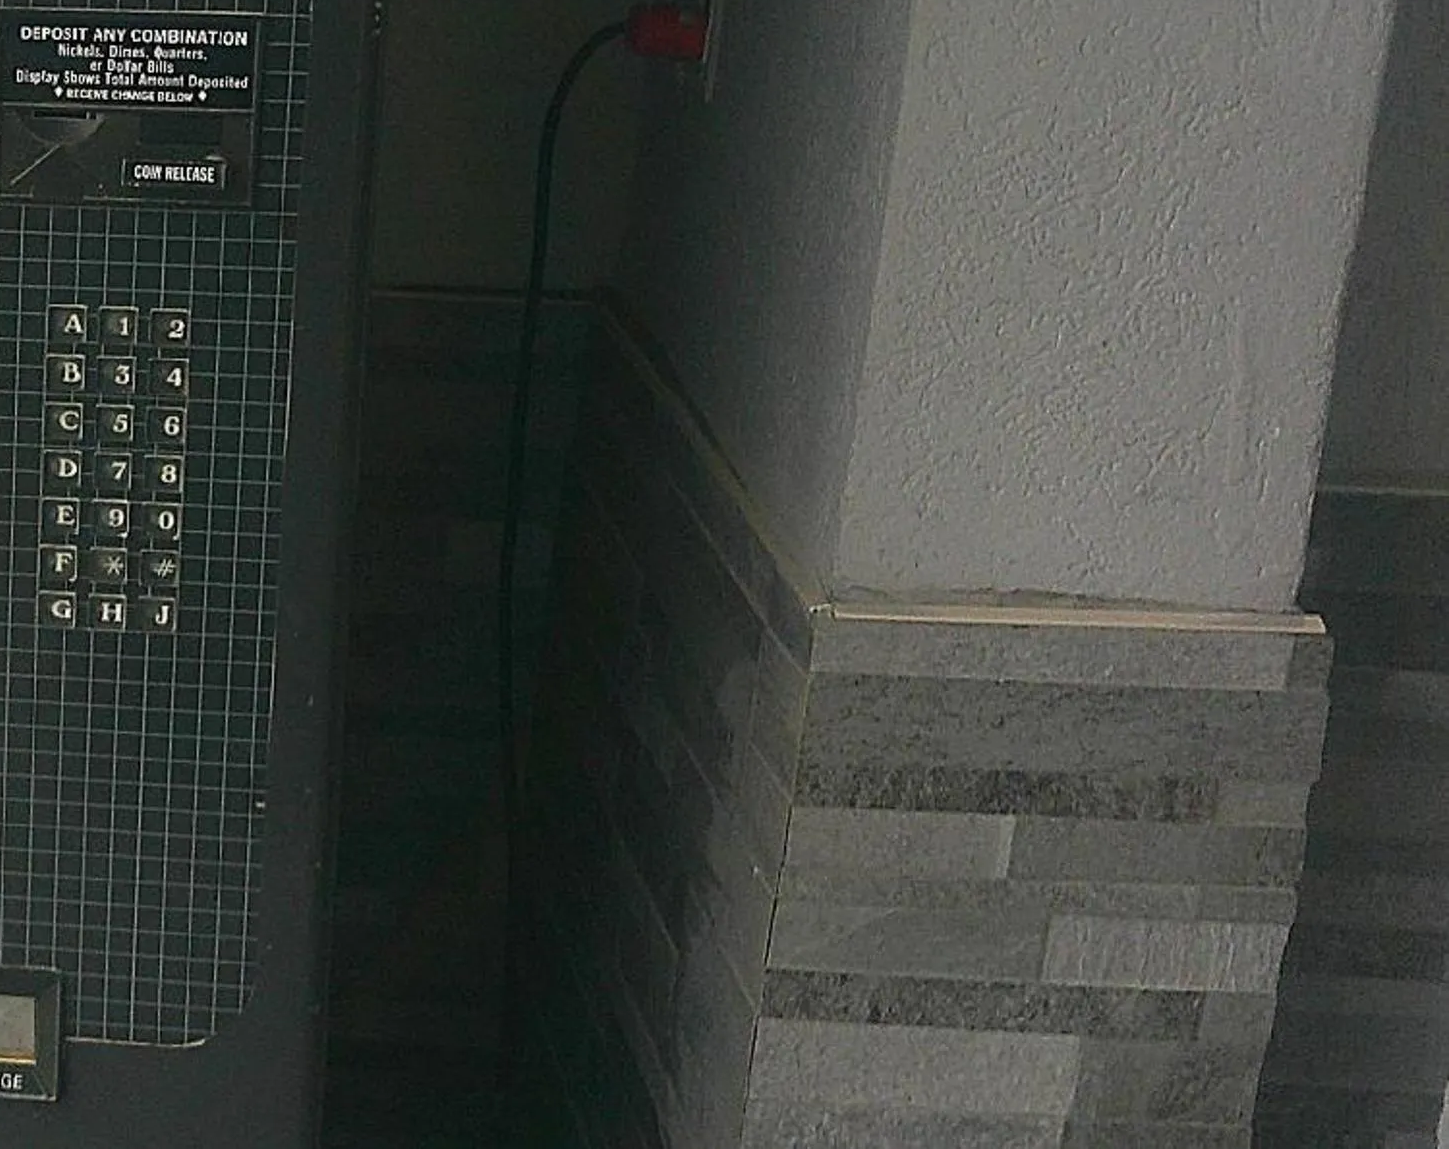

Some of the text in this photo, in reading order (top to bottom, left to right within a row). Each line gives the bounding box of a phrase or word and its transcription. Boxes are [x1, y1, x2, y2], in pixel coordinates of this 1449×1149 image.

[20, 26, 248, 46] DEPOSIT ANY COMBINATION
[90, 59, 174, 74] or Dollar Bills
[16, 69, 249, 89] Display Shows Total Amount Deposited
[66, 88, 193, 102] RECEIVE CHANGE BELOW
[133, 164, 216, 183] COIN RELEASE
[64, 314, 185, 338] A 1 2
[62, 362, 182, 386] B 3 4
[59, 410, 180, 436] C 5 6
[58, 458, 177, 483] D 7 8
[56, 505, 174, 529] E 9 0
[54, 552, 72, 572] F
[154, 558, 177, 577] #
[51, 600, 169, 625] G H J
